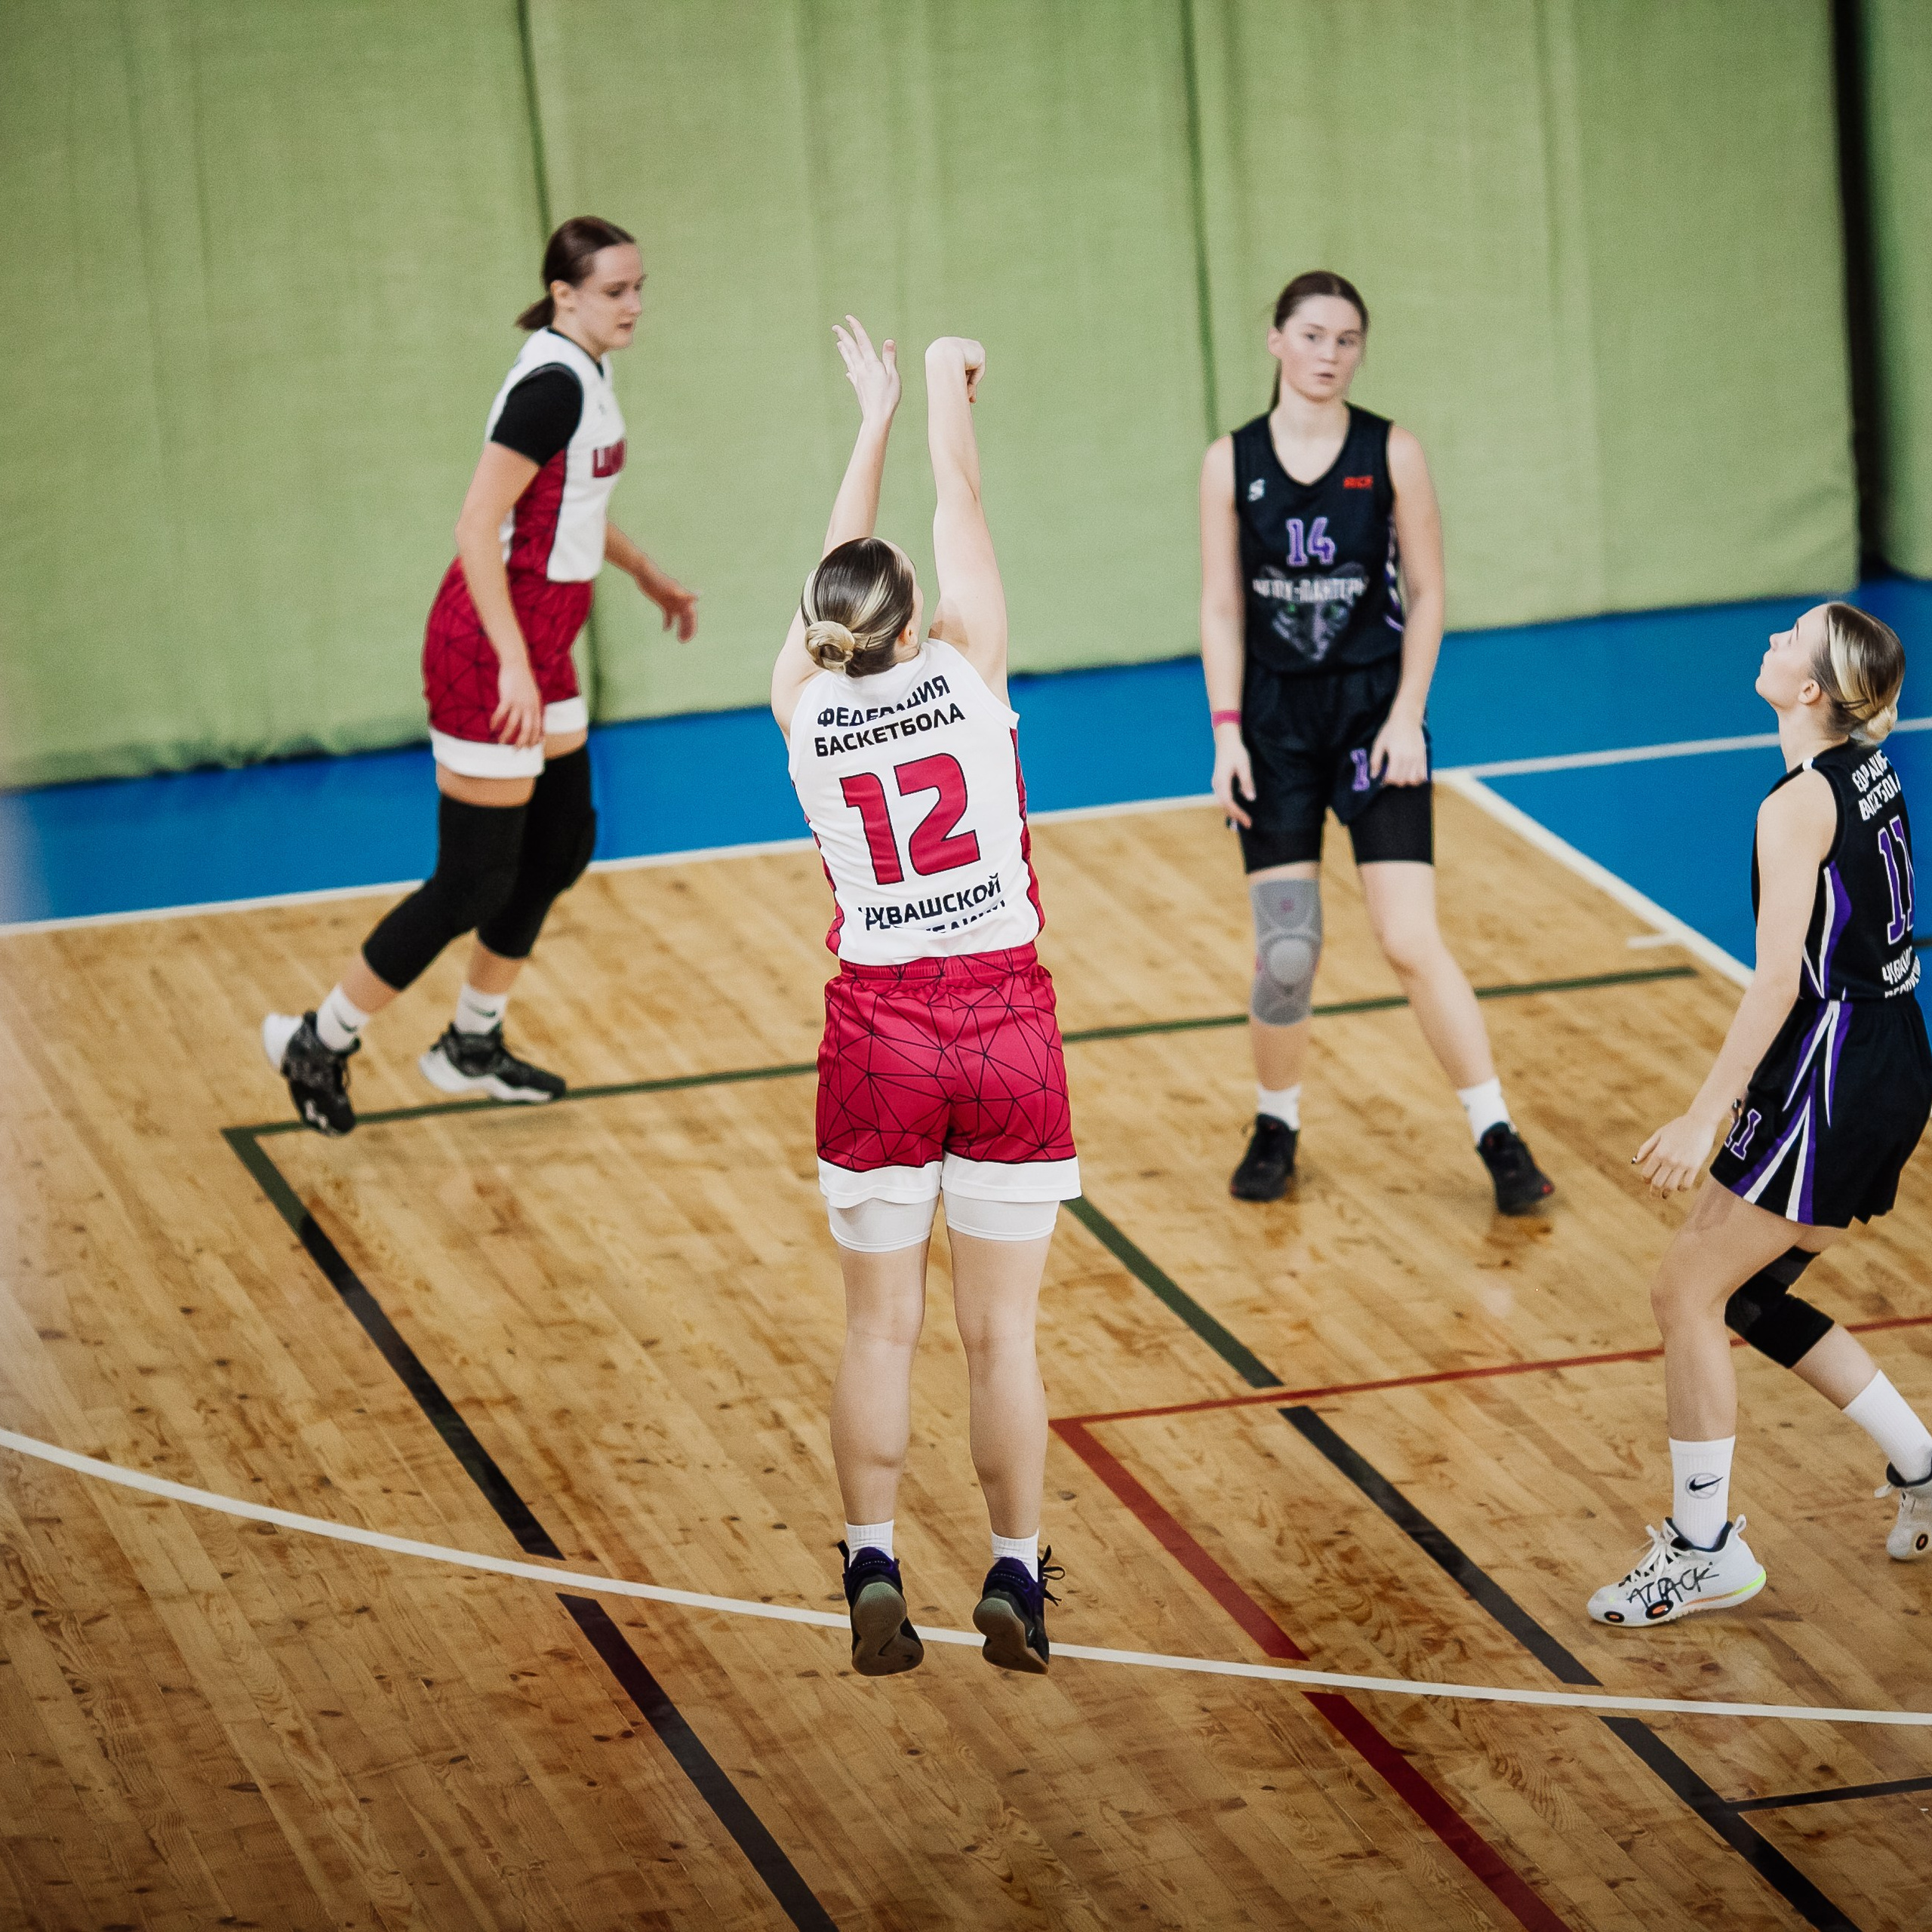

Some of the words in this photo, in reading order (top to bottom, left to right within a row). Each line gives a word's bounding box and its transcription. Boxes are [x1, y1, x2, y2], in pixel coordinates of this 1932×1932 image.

[1286, 516, 1336, 566] 14
[815, 703, 967, 758] БАСКЕТБОЛА
[839, 752, 981, 885] 12
[1878, 814, 1915, 946] 11
